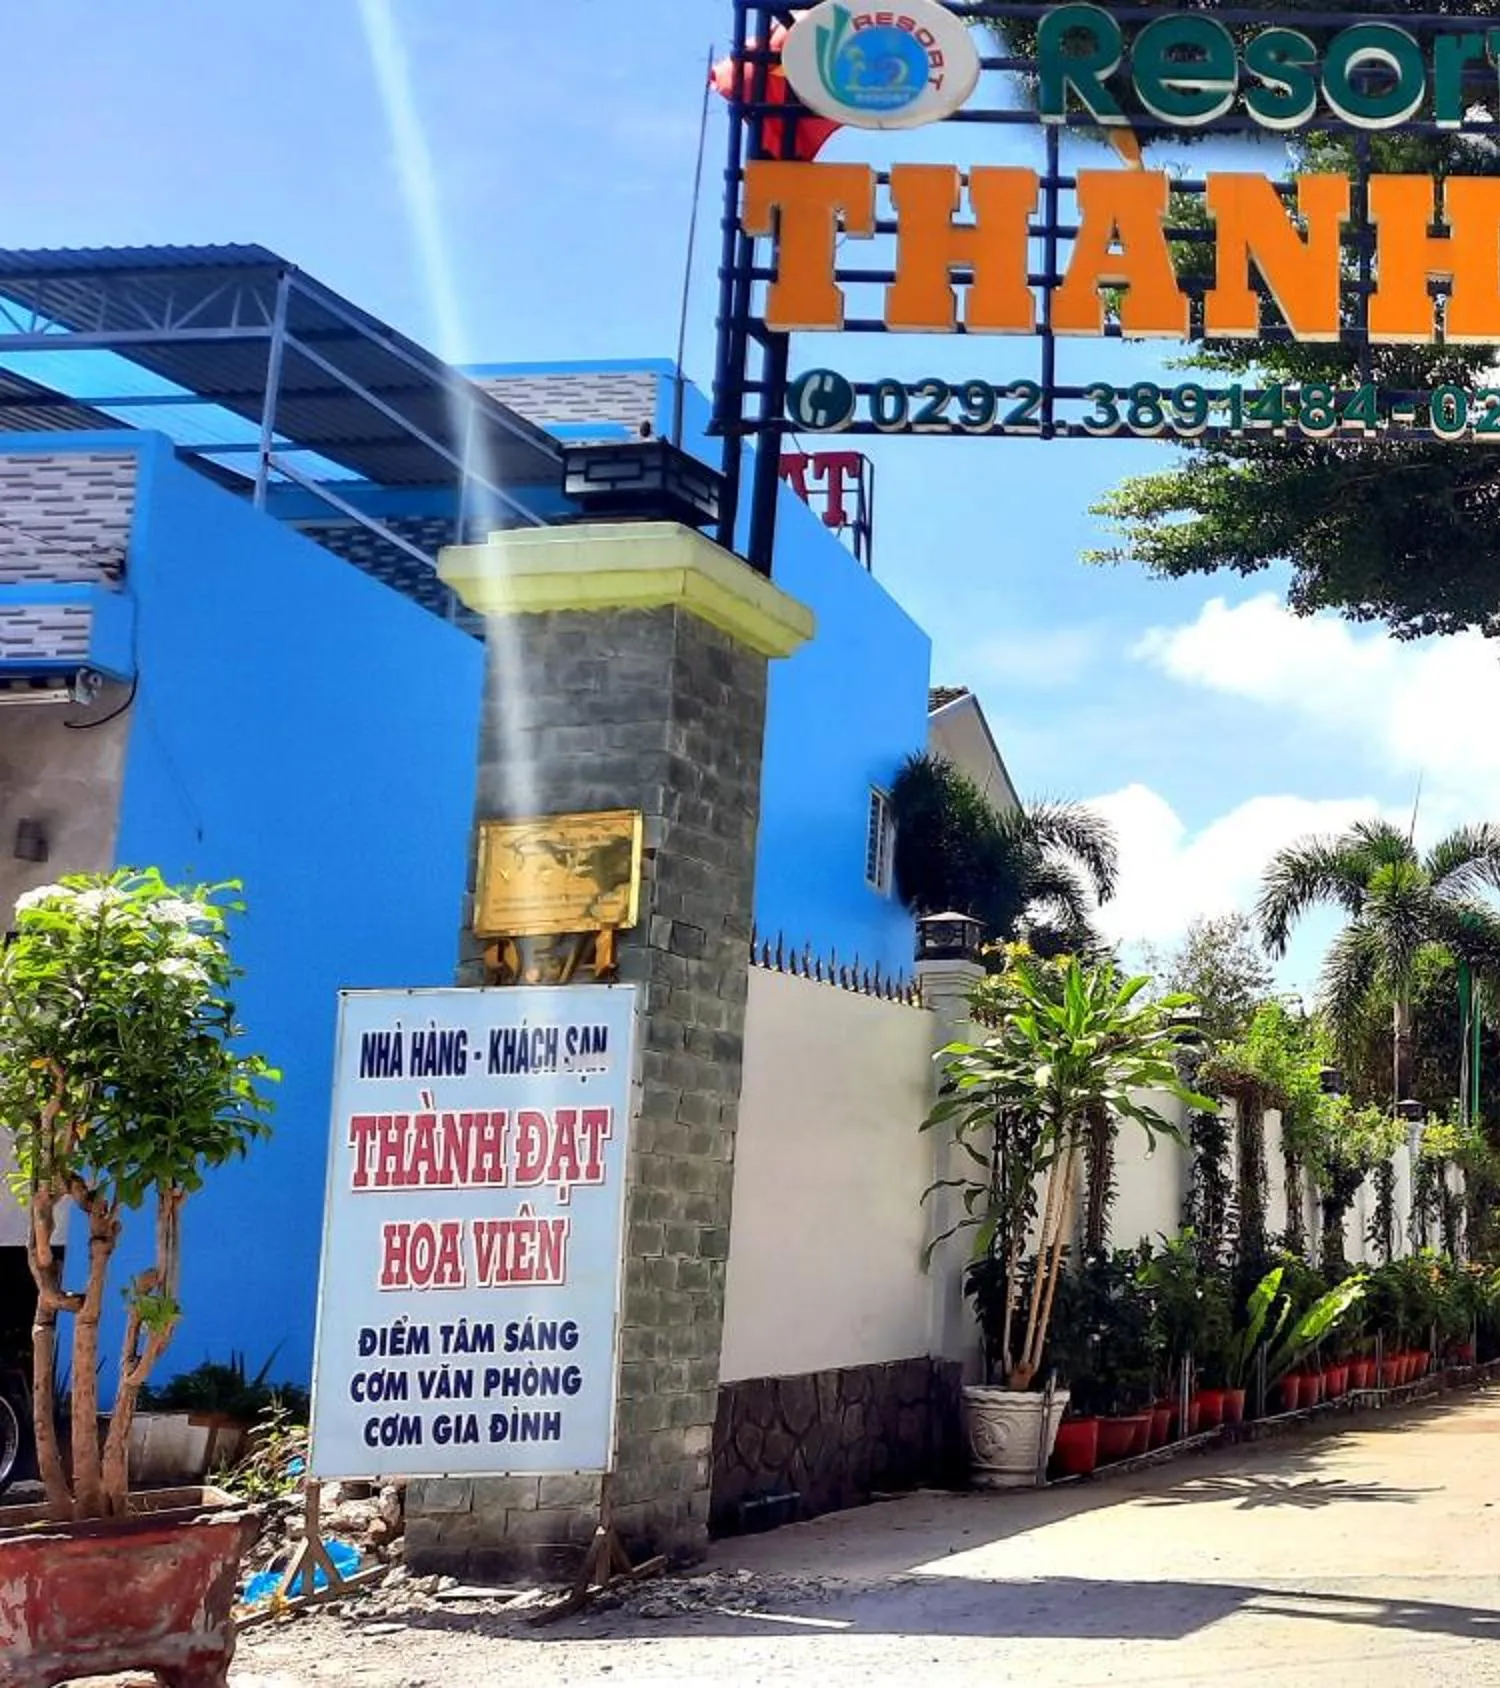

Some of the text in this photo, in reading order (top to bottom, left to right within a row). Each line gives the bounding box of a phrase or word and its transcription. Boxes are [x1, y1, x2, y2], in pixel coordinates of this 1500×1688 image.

[852, 11, 945, 92] RESORT
[359, 1021, 403, 1079] NHÀ
[410, 1019, 469, 1077] HÀNG
[487, 1018, 560, 1075] KHÁCH
[349, 1090, 609, 1203] THÀNH ĐẠT
[380, 1203, 568, 1288] HOA VIÊN
[357, 1315, 580, 1357] ĐIỂM TÂM SÁNG
[350, 1360, 583, 1403] CƠM VĂN PHÒNG
[363, 1405, 562, 1447] CƠM GIA ĐÌNH
